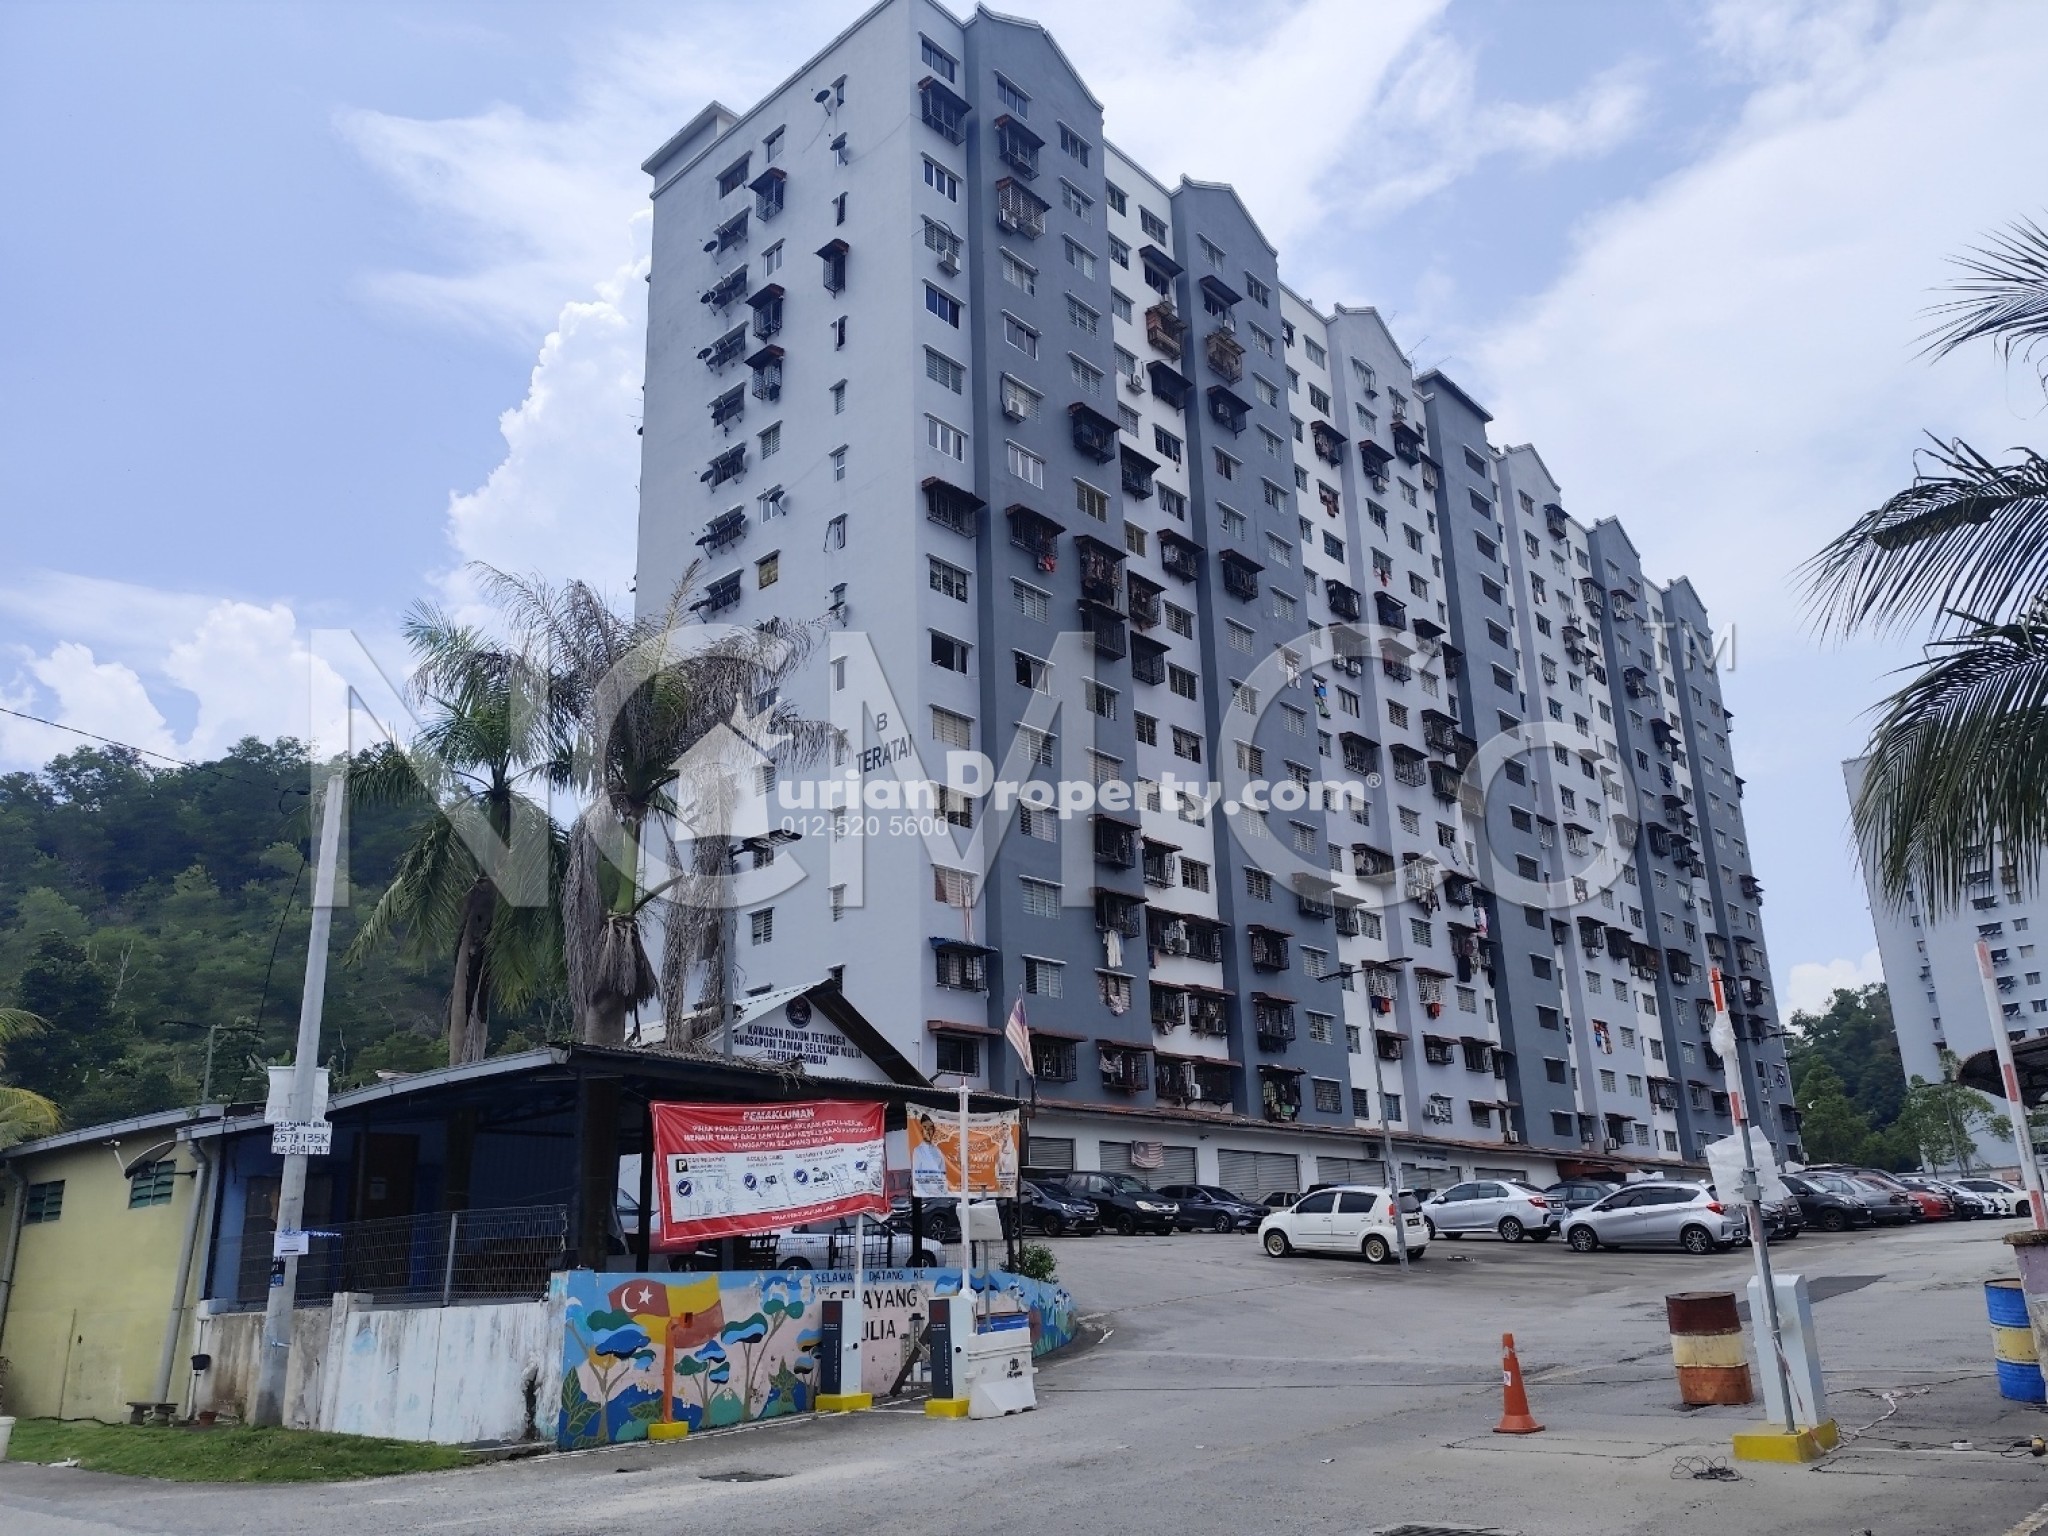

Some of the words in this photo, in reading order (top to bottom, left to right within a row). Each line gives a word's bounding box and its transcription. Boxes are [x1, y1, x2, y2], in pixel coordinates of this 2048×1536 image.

[877, 712, 888, 732] B
[856, 733, 912, 775] TERATAI
[733, 1034, 776, 1048] ANGSAPURI
[747, 1025, 784, 1039] KAWASAN
[810, 1032, 847, 1047] TETANGGA
[743, 1107, 815, 1121] PEMAKLUMAN
[815, 1271, 855, 1283] SELAMA
[868, 1270, 904, 1282] DATANG
[913, 1269, 925, 1279] KE
